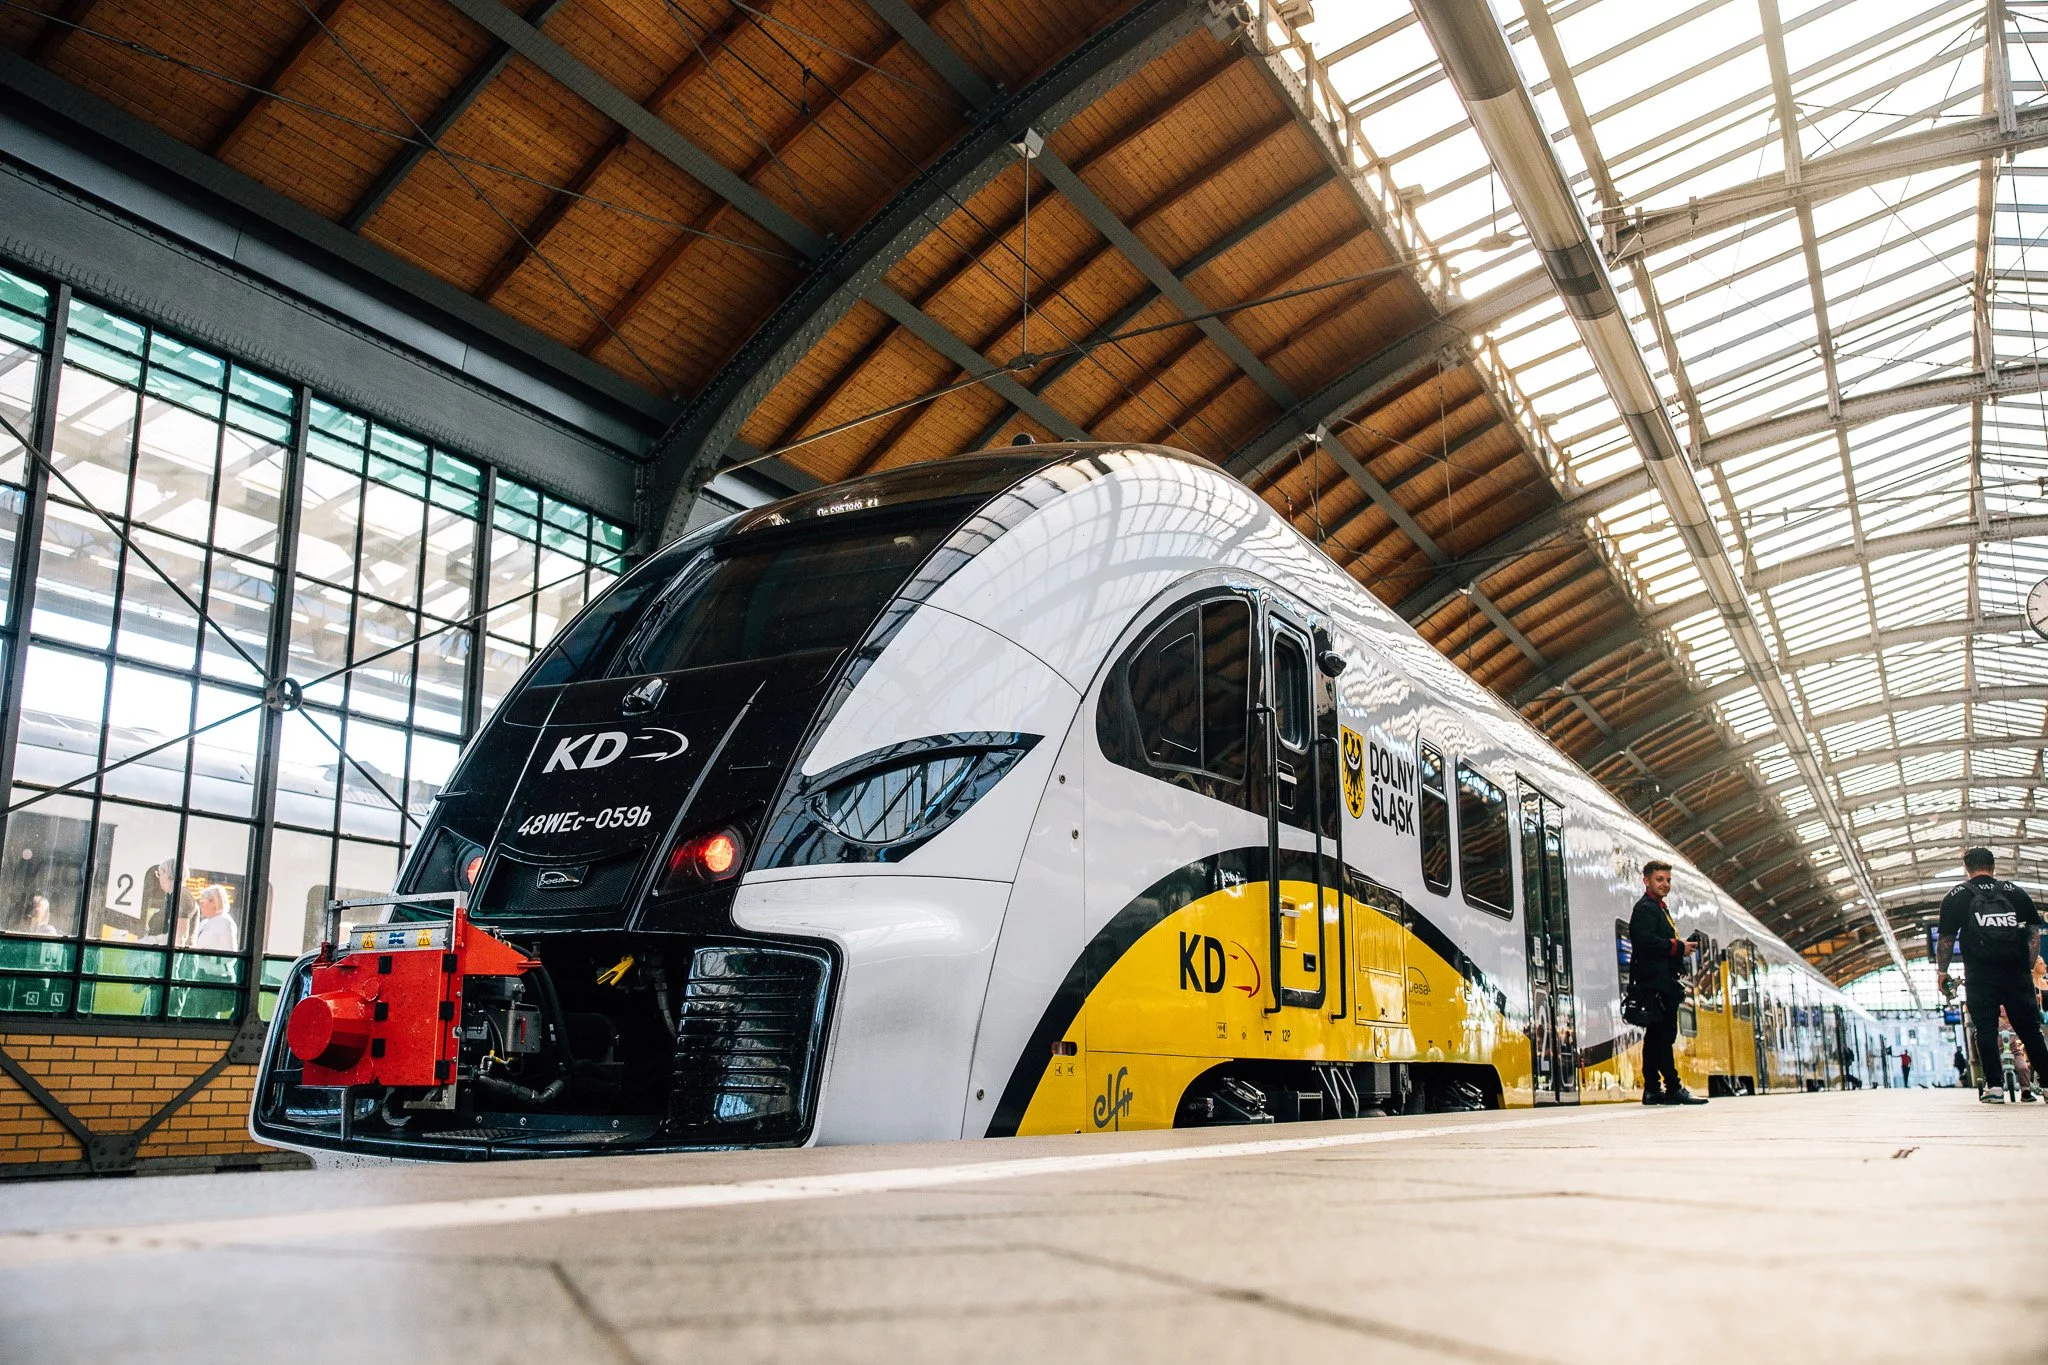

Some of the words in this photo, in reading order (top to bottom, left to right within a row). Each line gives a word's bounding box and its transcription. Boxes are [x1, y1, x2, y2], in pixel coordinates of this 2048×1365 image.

[542, 731, 628, 774] KD
[1370, 741, 1414, 796] DOLNY
[518, 805, 652, 836] 48WEc-059b
[1372, 777, 1415, 836] ŚLĄSK
[114, 873, 134, 906] 2
[1974, 911, 2018, 928] VANS
[1180, 931, 1226, 994] KD
[1408, 981, 1430, 995] pesa
